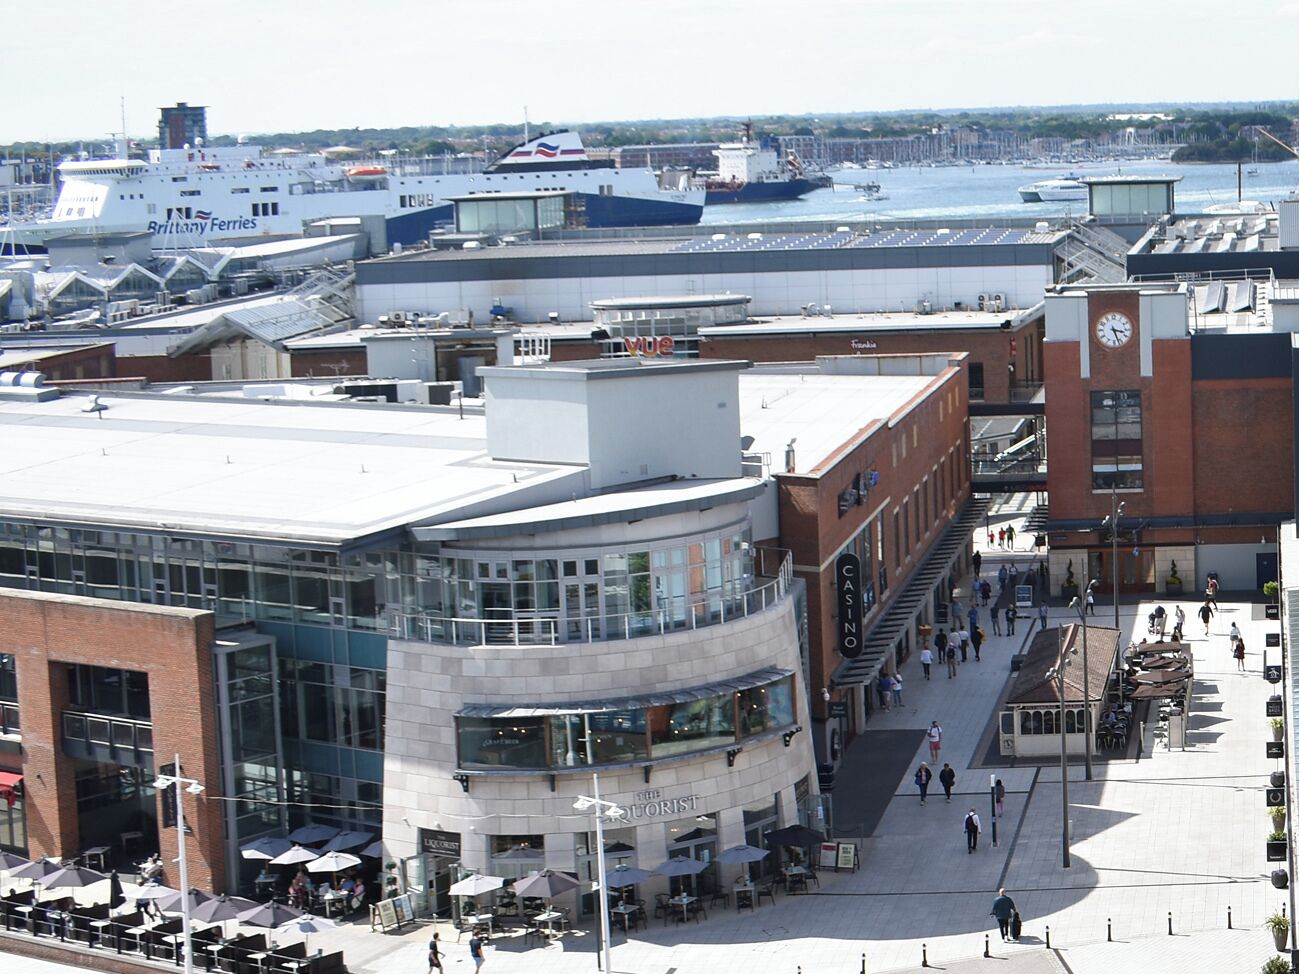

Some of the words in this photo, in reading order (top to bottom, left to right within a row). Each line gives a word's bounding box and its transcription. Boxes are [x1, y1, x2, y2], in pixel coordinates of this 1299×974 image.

[148, 219, 207, 235] Brittany
[210, 216, 257, 232] Ferries
[851, 339, 877, 349] Frankie
[843, 565, 857, 648] CASINO
[637, 790, 661, 801] THE
[605, 795, 700, 824] QUORIST
